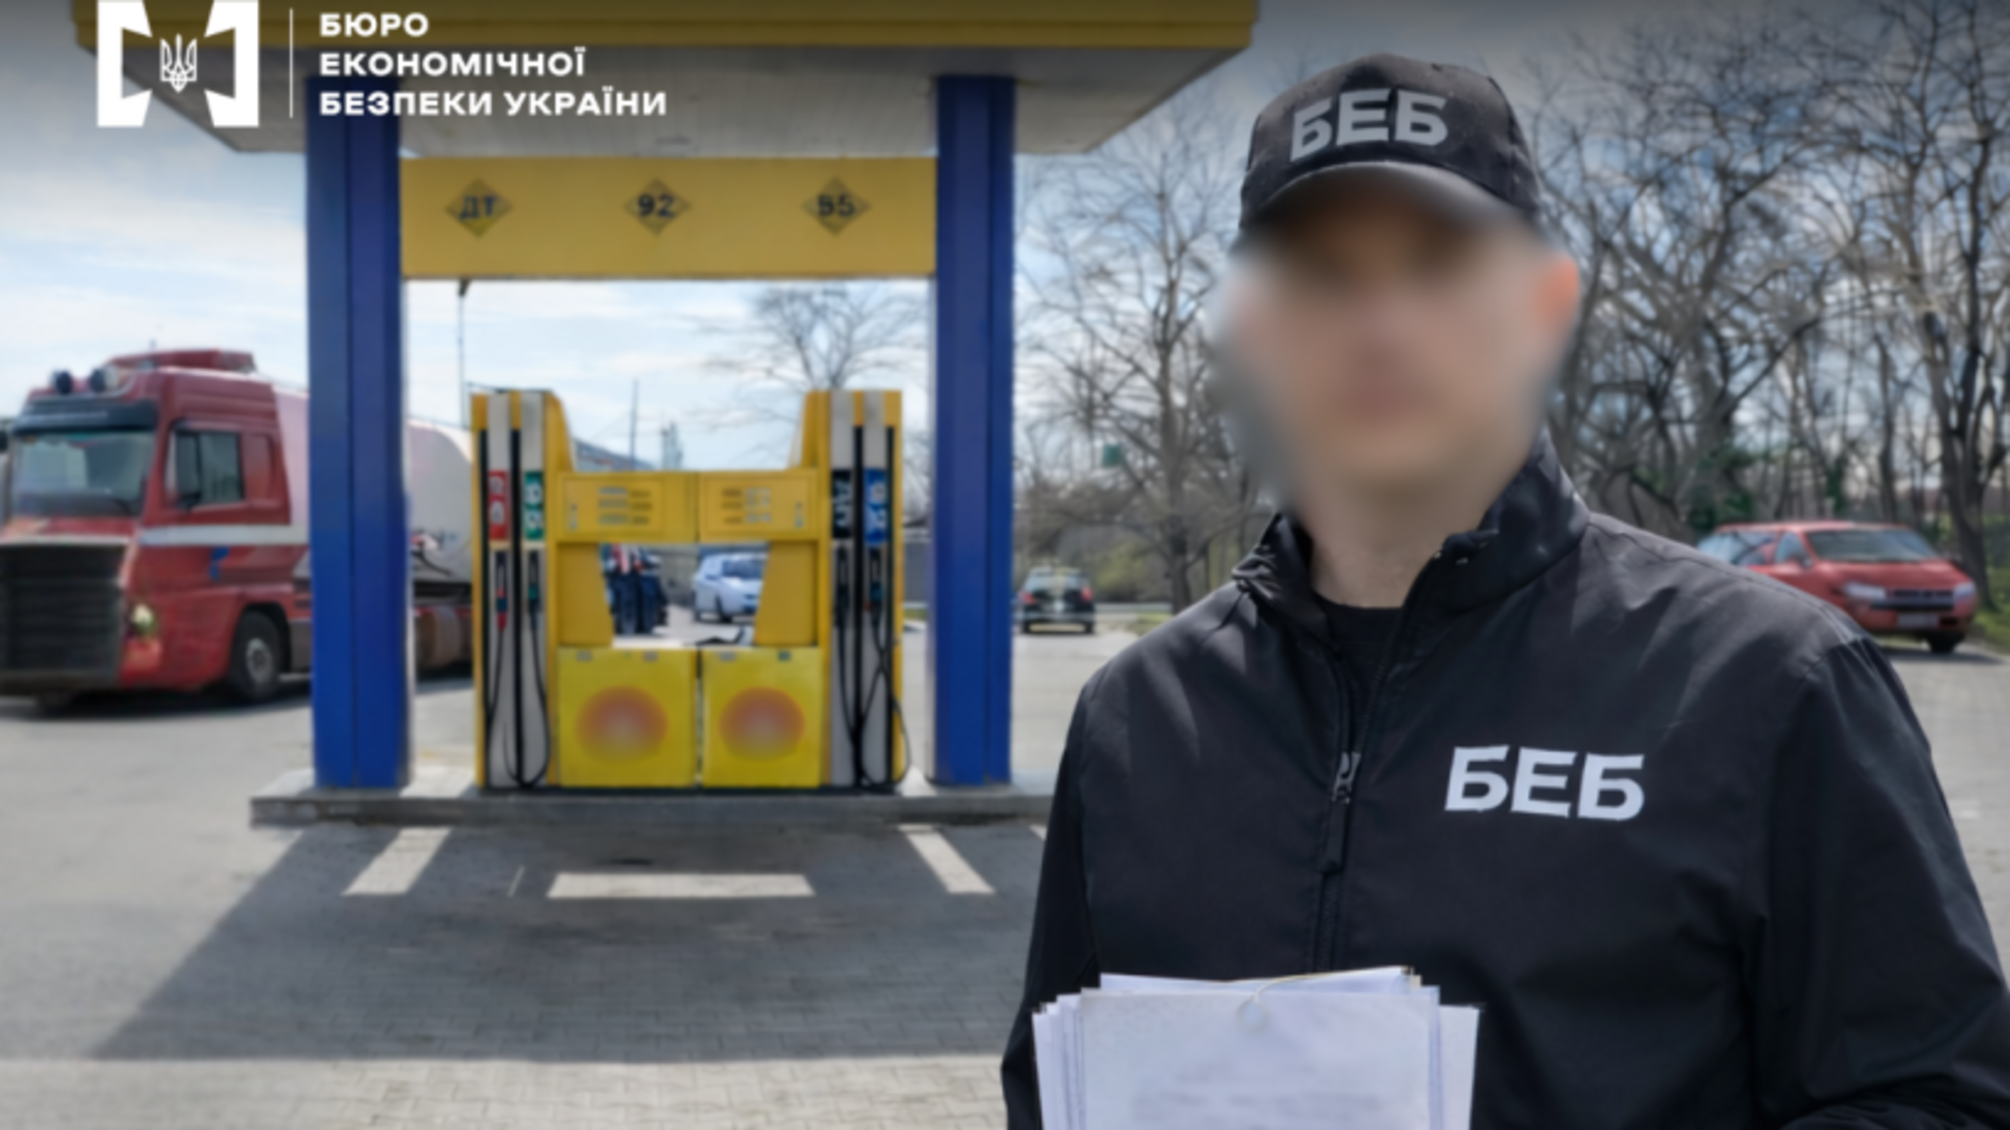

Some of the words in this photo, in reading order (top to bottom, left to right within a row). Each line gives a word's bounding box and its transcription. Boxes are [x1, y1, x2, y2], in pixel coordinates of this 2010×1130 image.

[1289, 87, 1449, 162] БЕБ
[638, 193, 676, 218] 92
[1444, 744, 1645, 821] БЕБ
